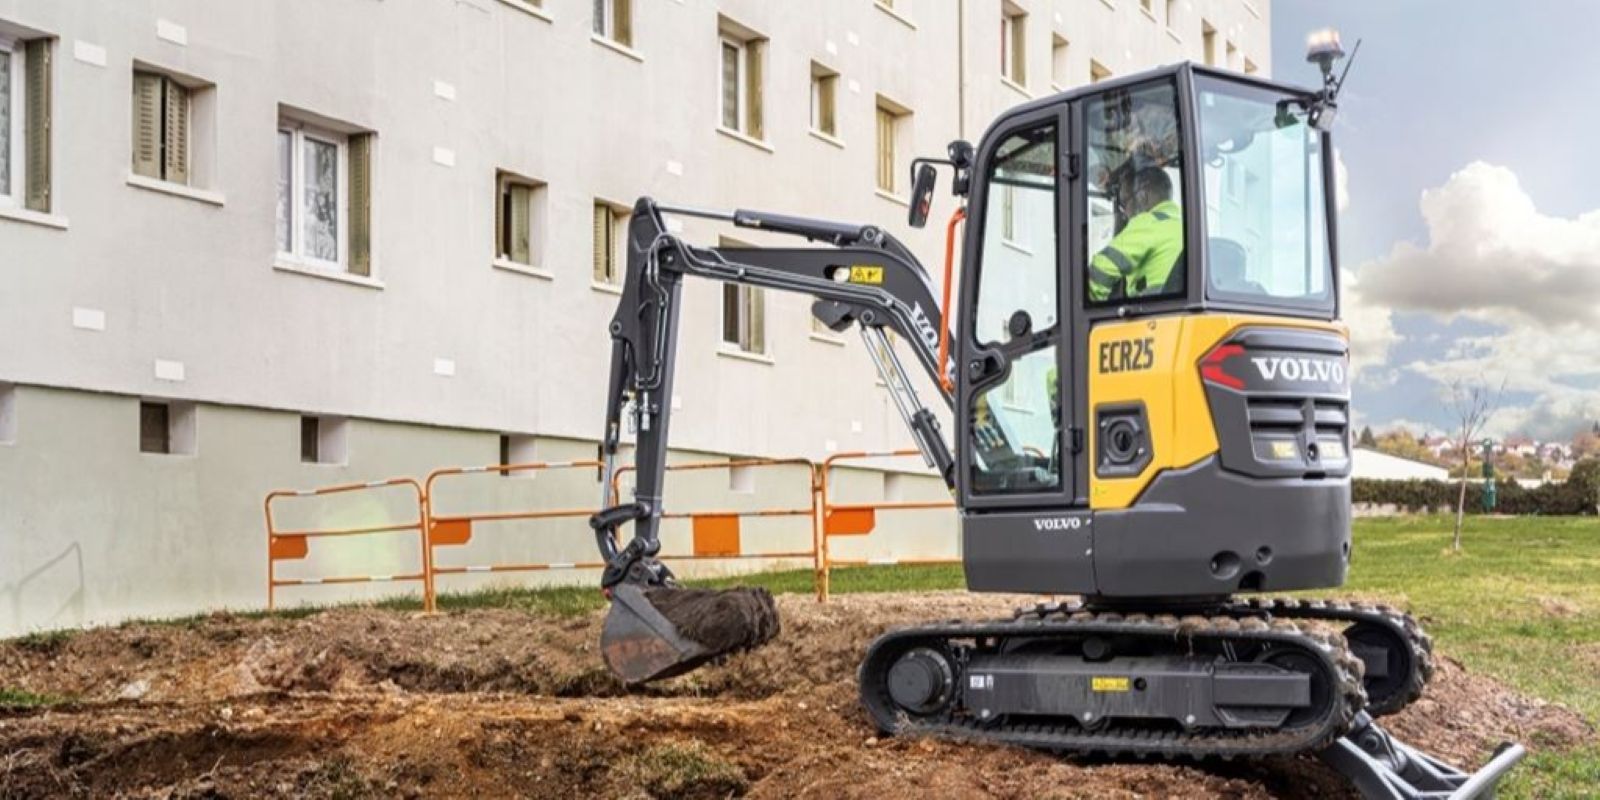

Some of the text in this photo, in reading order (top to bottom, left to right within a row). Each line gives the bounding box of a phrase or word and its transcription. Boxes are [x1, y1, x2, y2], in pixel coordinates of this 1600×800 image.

[1099, 337, 1154, 374] ECR25
[1251, 357, 1344, 384] VOLVO
[1034, 517, 1081, 530] VOLVO
